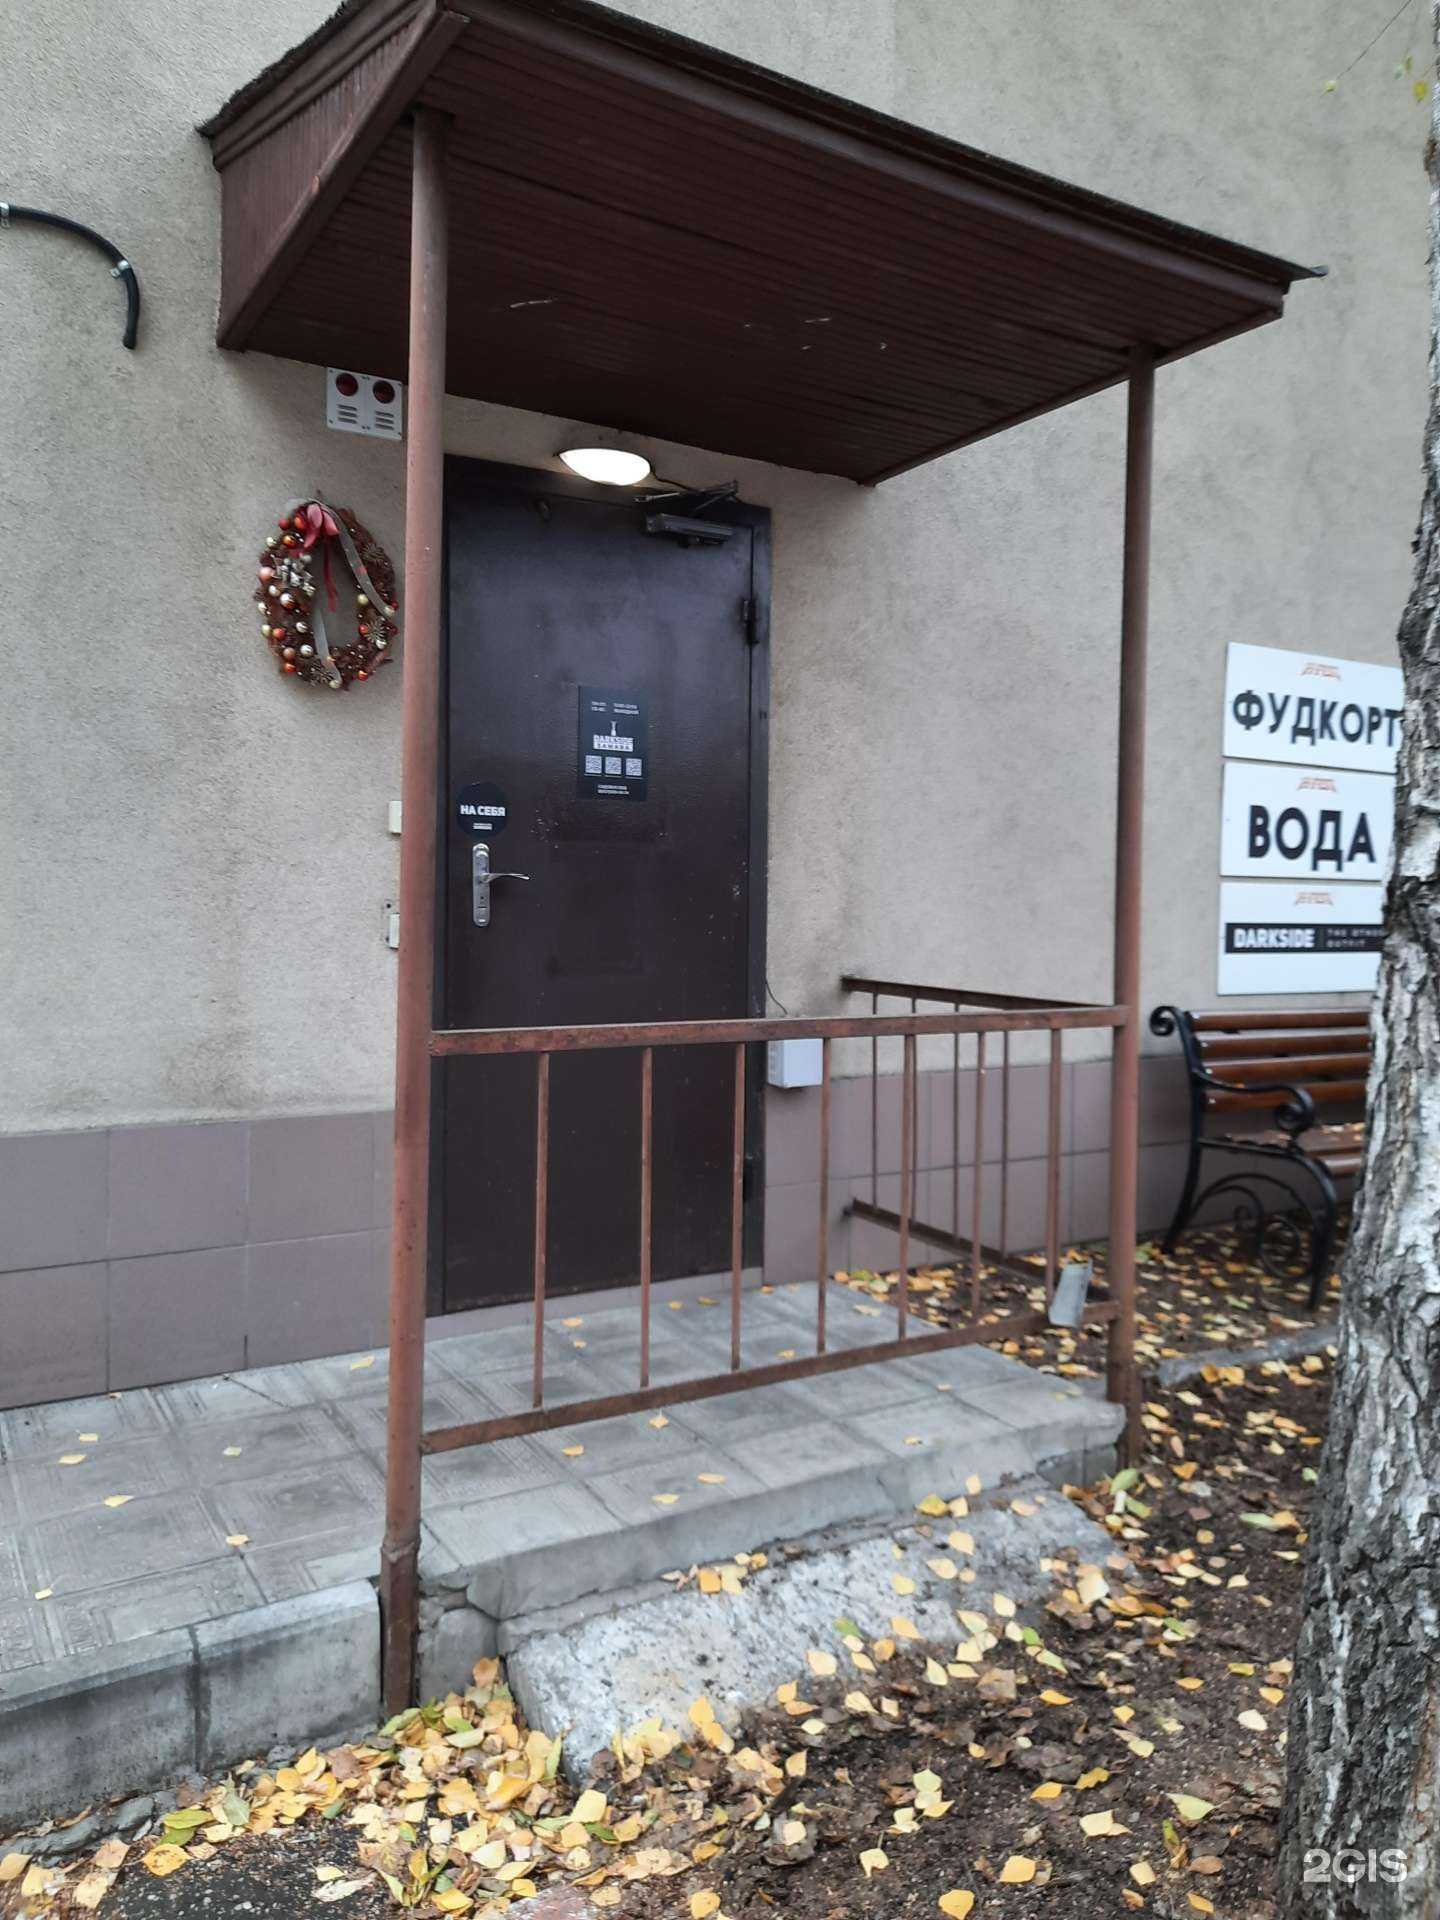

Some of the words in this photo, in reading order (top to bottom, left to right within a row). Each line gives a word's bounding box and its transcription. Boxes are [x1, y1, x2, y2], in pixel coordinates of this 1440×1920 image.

[1233, 690, 1403, 747] ФУДКОРТ
[460, 805, 476, 815] НА
[477, 806, 505, 816] СЕБЯ
[1248, 804, 1376, 872] ВОДА
[1233, 928, 1315, 948] DARKSIDE
